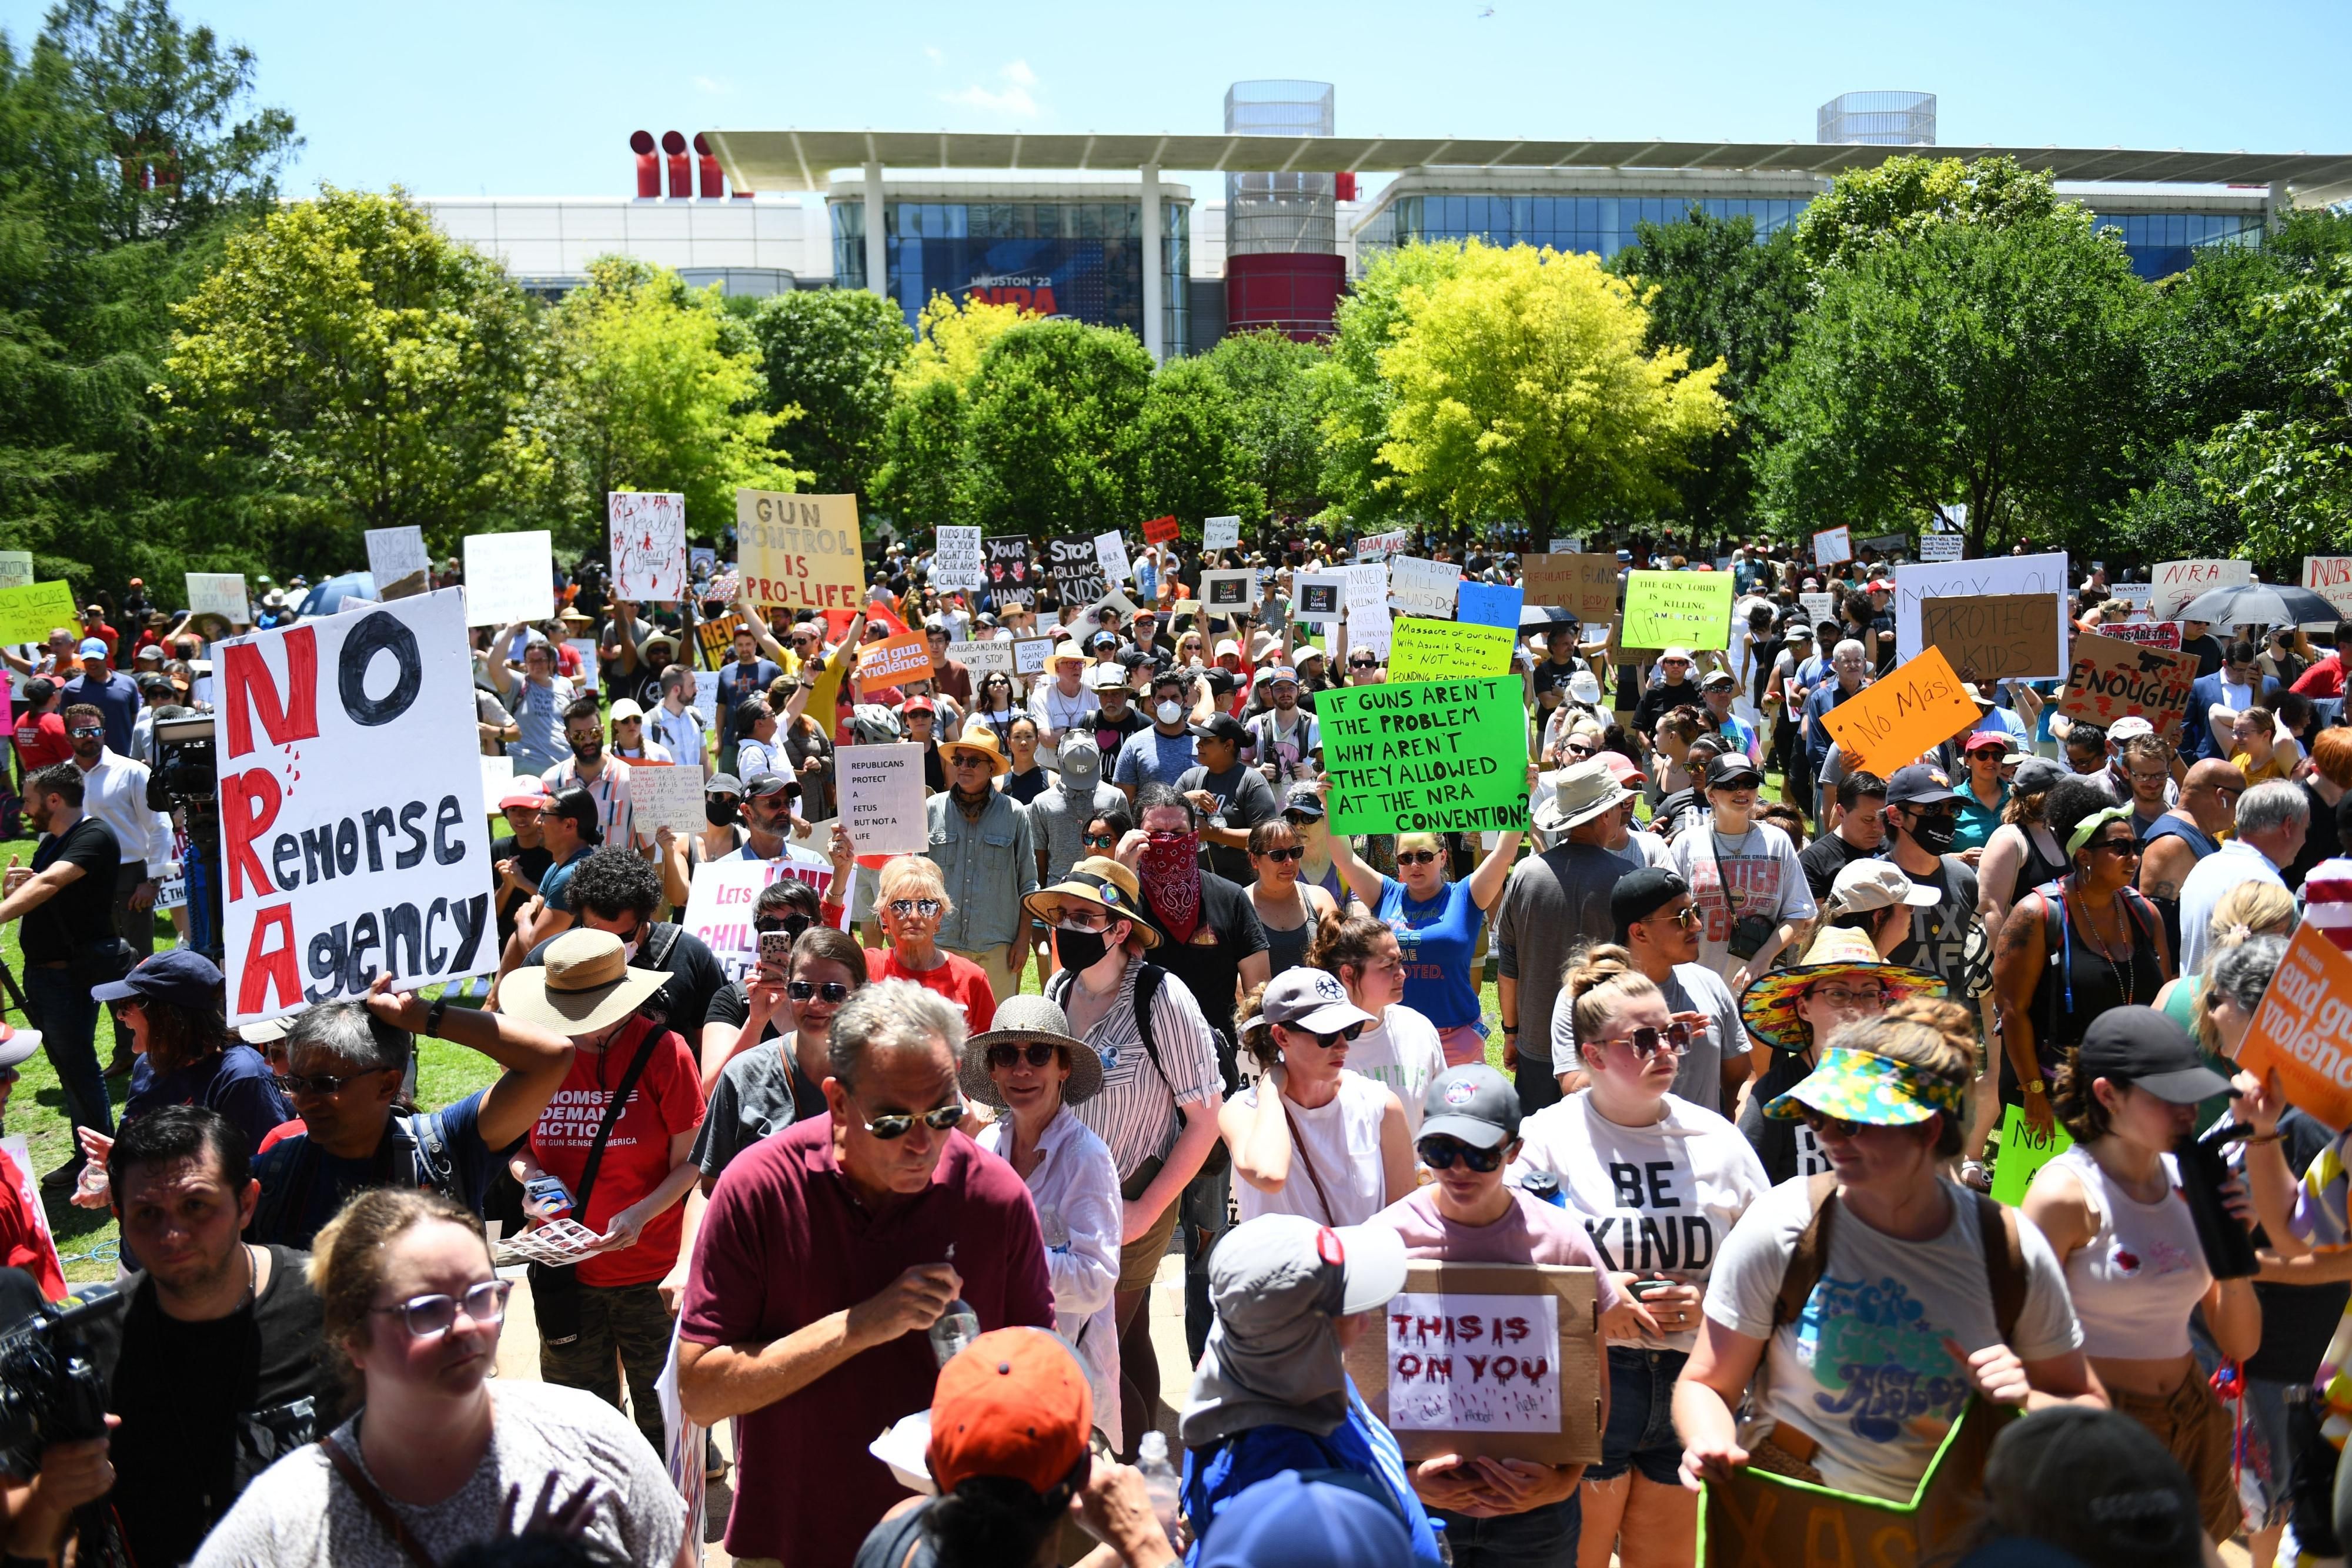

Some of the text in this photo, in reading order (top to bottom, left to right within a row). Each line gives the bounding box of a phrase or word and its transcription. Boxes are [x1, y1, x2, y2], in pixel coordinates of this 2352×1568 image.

[971, 276, 1051, 286] HOUSTON '22
[756, 498, 821, 527] GUN
[623, 502, 676, 544] Really
[1228, 520, 1239, 529] Kids
[369, 530, 420, 553] NOT
[739, 521, 854, 556] CONTROL
[940, 529, 976, 539] KIDS DIE
[622, 534, 676, 574] Again?
[938, 550, 974, 560] RIGHT TO
[940, 540, 975, 550] FOR YOUR
[987, 540, 1025, 561] YOUR
[1051, 540, 1094, 561] STOP
[1358, 537, 1405, 554] BAN AK's
[372, 551, 420, 571] VERY
[784, 554, 808, 578] IS
[938, 560, 977, 570] BEAR ARMS
[1053, 561, 1100, 579] KILLING
[1397, 558, 1461, 577] MASKS DON'T
[939, 573, 977, 586] CHANGE
[1405, 574, 1437, 590] KILL
[1528, 564, 1617, 584] REGULATE GUNS
[2164, 564, 2219, 584] NRA
[25, 589, 63, 606] MORE
[746, 577, 856, 608] PRO-LIFE
[991, 587, 1036, 609] HANDS
[1059, 576, 1104, 606] KIDS
[1465, 586, 1512, 601] FOLLOW
[1688, 584, 1718, 592] LOBBY
[1903, 582, 1947, 613] MY
[2325, 589, 2352, 601] Cruz
[1351, 598, 1378, 609] KILLING
[1392, 593, 1453, 611] GUNS DO
[1534, 593, 1609, 607] NOT MY BODY
[1663, 600, 1705, 610] KILLING
[0, 606, 68, 621] THOUGHTS
[1654, 613, 1719, 622] AMERICANS!
[1923, 600, 2055, 645] PROTECT
[1355, 630, 1389, 638] THINKING
[1398, 623, 1446, 636] Massacre
[1484, 633, 1511, 644] children
[2133, 631, 2171, 640] ARE THE
[860, 647, 889, 667] end
[890, 643, 922, 661] gun
[1021, 651, 1048, 660] AGAINST
[1396, 638, 1486, 655] With RiFles
[862, 654, 930, 678] violence
[960, 654, 1003, 664] WONT STOP
[1420, 653, 1449, 665] NOT
[1452, 659, 1477, 667] what
[1963, 641, 2032, 674] KIDS
[223, 610, 422, 760] NO
[1393, 670, 1430, 683] FOUNDING
[2067, 663, 2190, 710] ENOUGH!
[1330, 680, 1498, 713] IF GUNS AREN'T
[1896, 664, 1960, 717] Más!
[1330, 707, 1481, 736] THE PROBLEM
[1335, 732, 1463, 763] WHY AREN'T
[851, 760, 904, 769] REPUBLICANS
[1331, 756, 1498, 789] THEY ALLOWED
[1338, 783, 1475, 815] AT THE NRA
[1395, 793, 1530, 831] CONVENTION?
[667, 820, 705, 829] ACTING!
[220, 767, 467, 903] Remorse
[716, 884, 752, 904] LETS
[1387, 918, 1416, 931] THE
[1912, 904, 1963, 942] TX
[236, 892, 489, 1016] Agency
[1910, 943, 1963, 977] AF
[2307, 955, 2324, 975] can
[2276, 962, 2331, 1017] end
[549, 1091, 603, 1105] MOMS
[604, 1137, 637, 1146] AMERICA
[2013, 1119, 2064, 1152] NOT
[1609, 1161, 1681, 1209] BE
[1585, 1216, 1713, 1271] KIND
[1391, 1313, 1531, 1349] THIS IS
[1395, 1353, 1548, 1388] ON YOU
